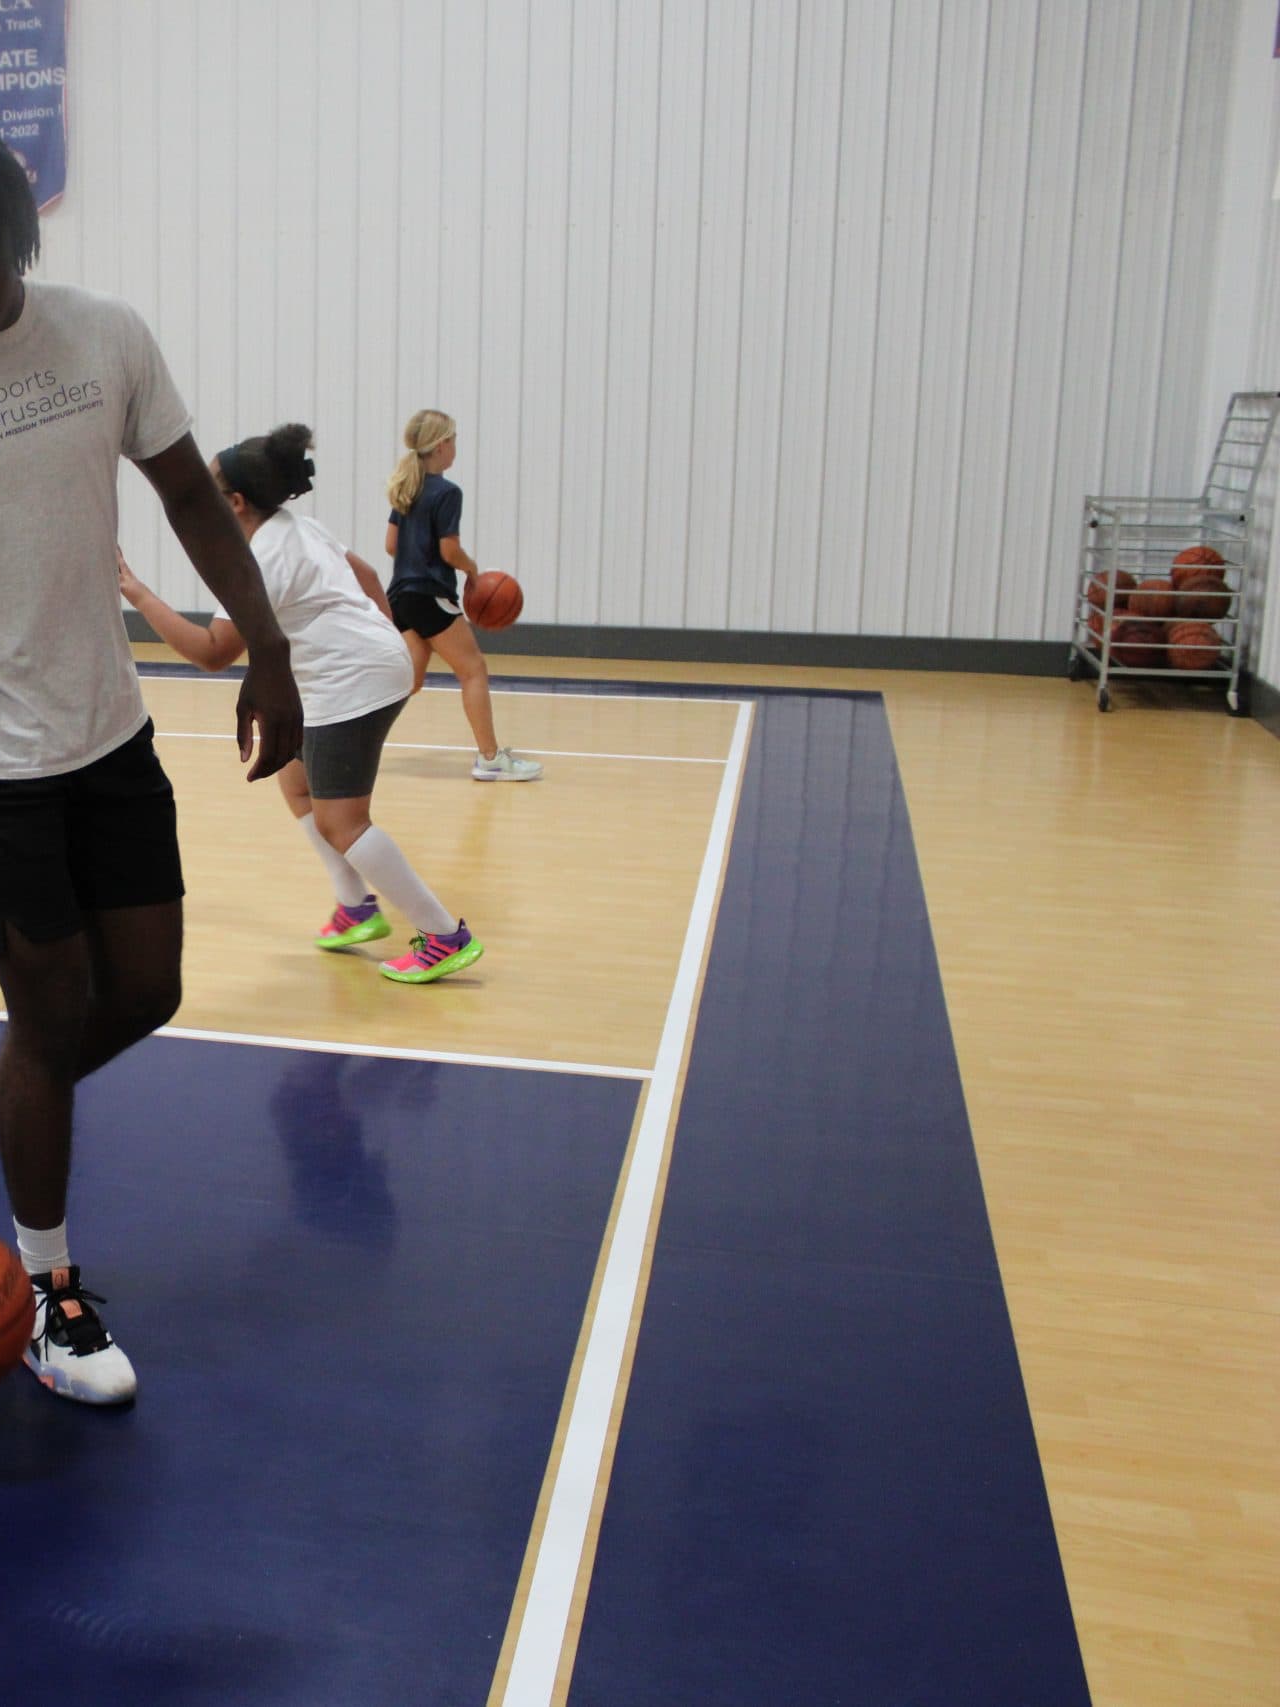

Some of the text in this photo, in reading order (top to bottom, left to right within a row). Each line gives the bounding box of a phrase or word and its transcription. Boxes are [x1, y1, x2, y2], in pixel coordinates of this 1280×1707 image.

[5, 16, 42, 31] Track
[2, 105, 54, 122] Division
[5, 422, 37, 438] MISSION
[39, 408, 76, 426] THROUGH
[77, 399, 104, 413] SPORTS
